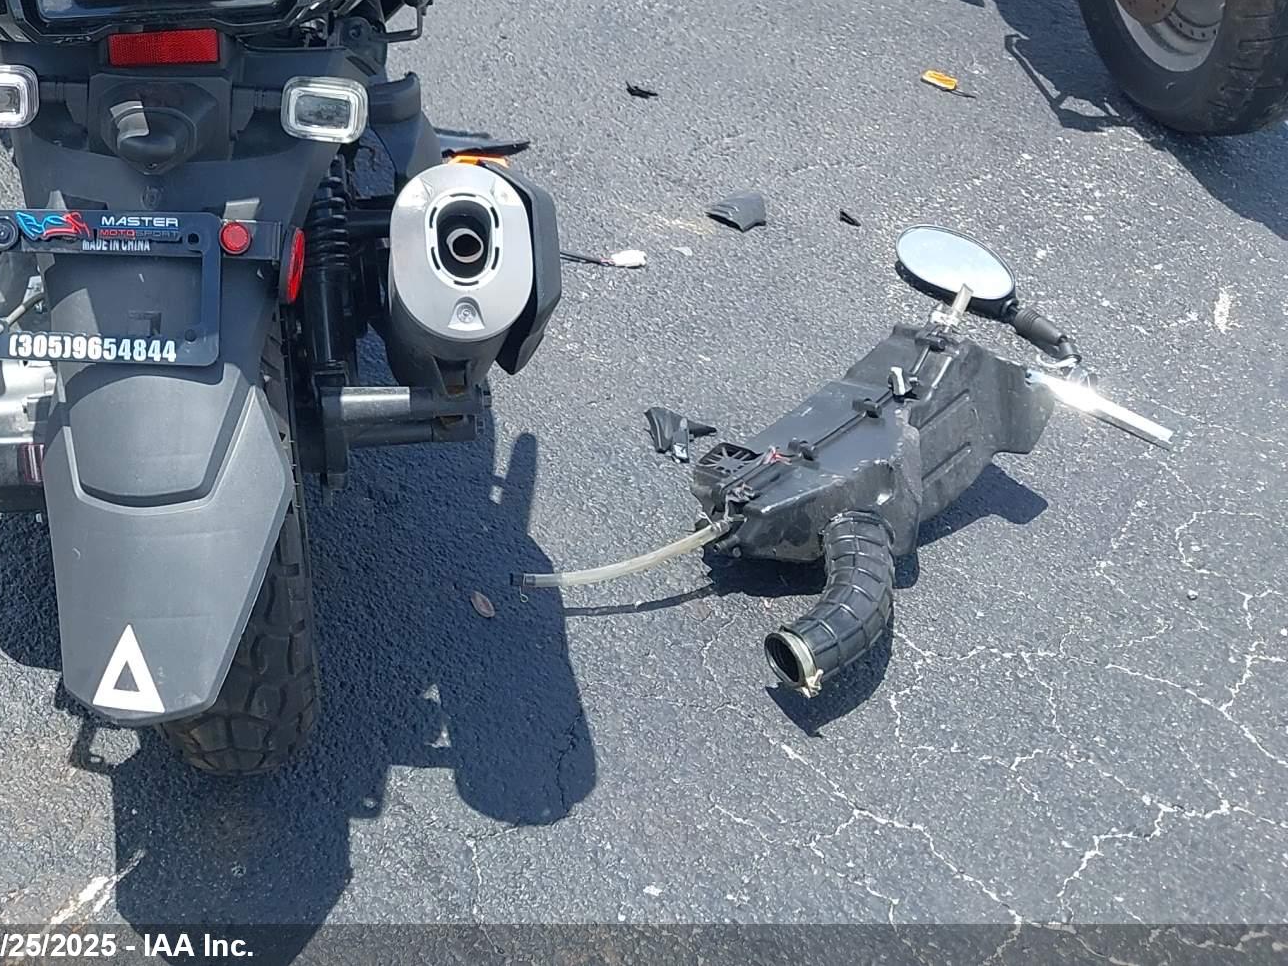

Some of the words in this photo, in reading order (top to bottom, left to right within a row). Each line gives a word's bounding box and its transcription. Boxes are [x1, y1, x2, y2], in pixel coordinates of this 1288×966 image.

[101, 216, 179, 227] MASTER
[82, 239, 108, 251] MADE
[109, 239, 120, 251] IN
[121, 239, 150, 251] CHINA
[8, 334, 177, 362] (305)9654844
